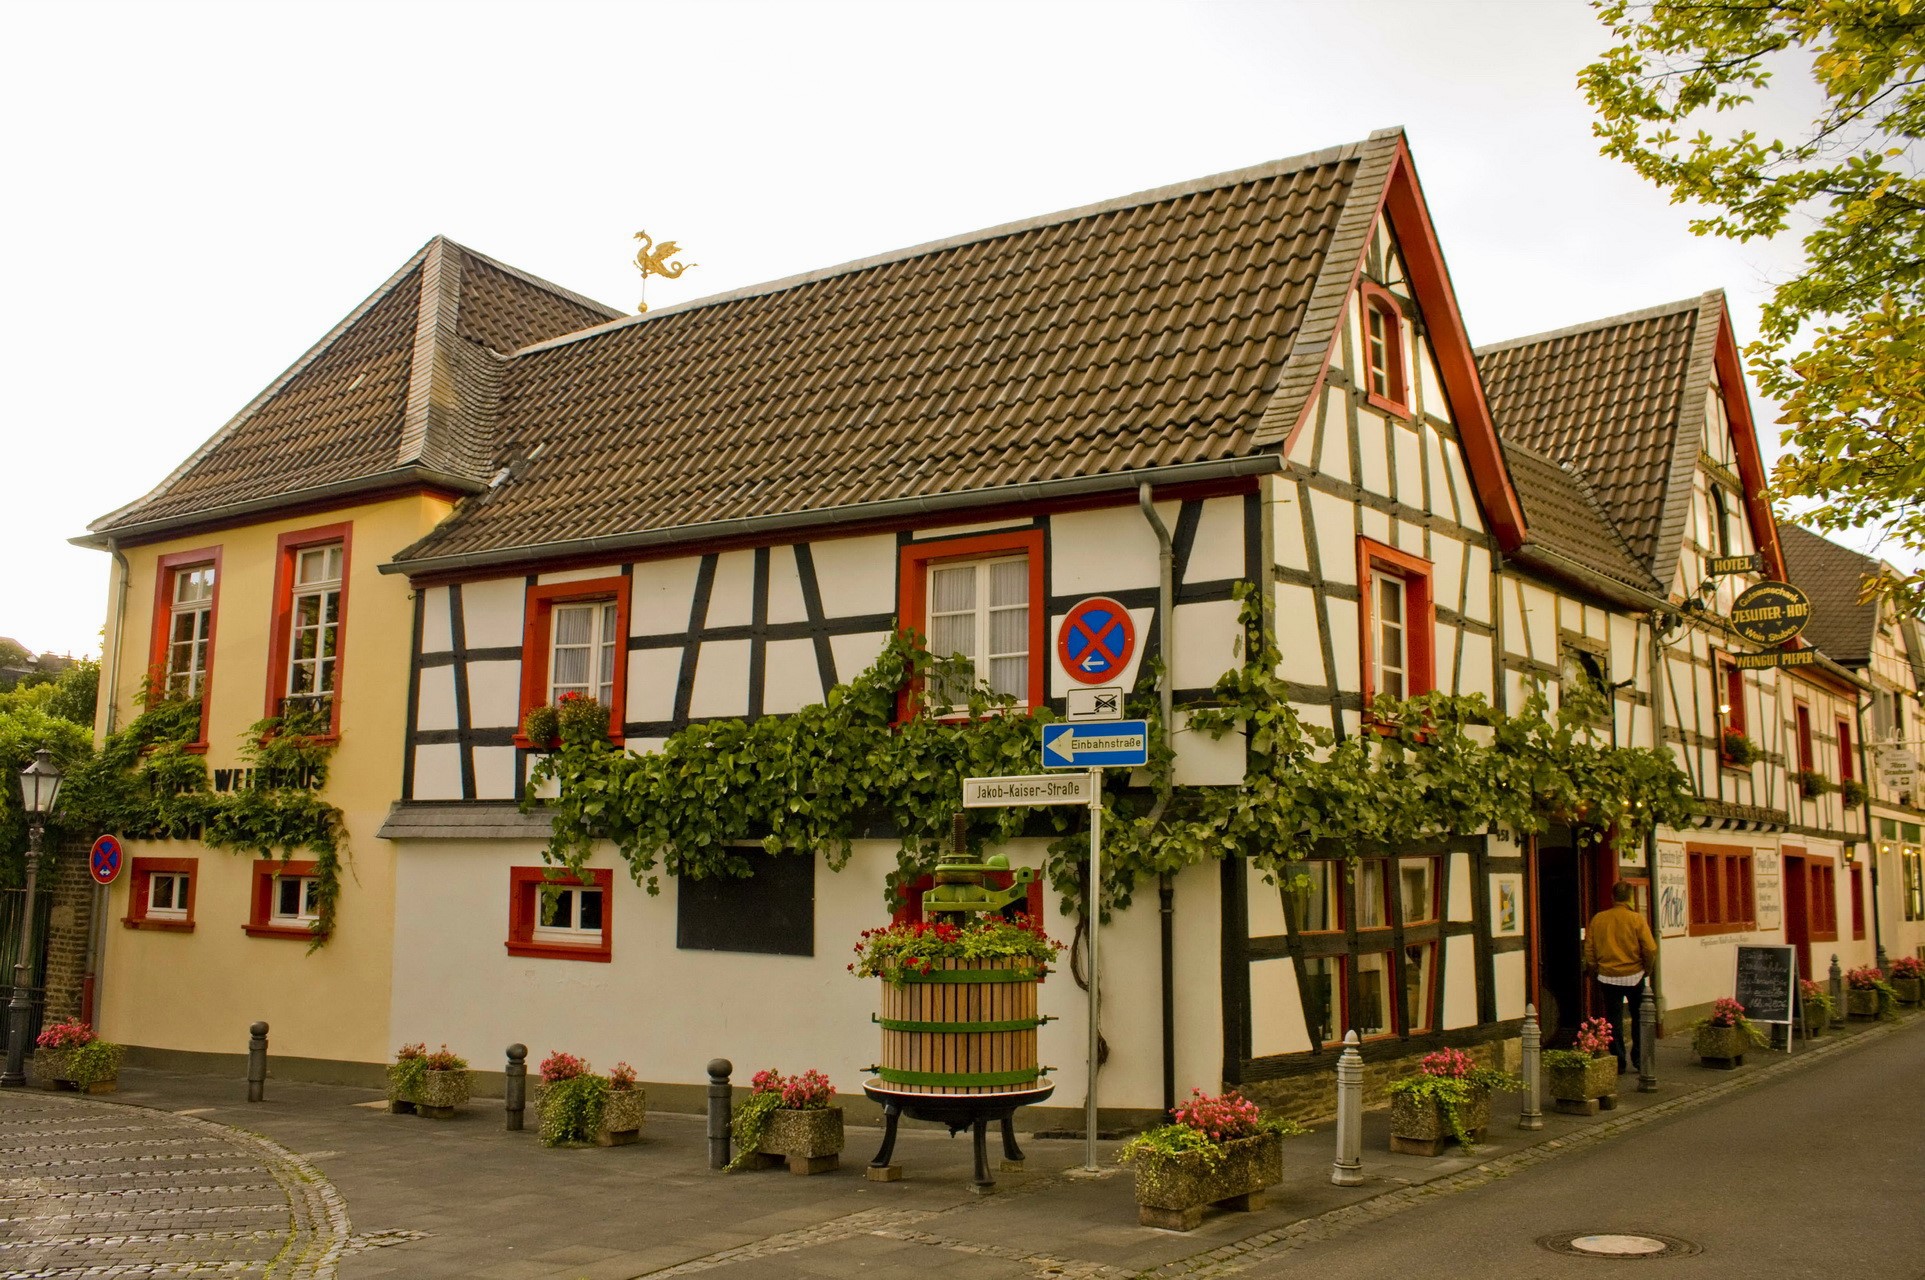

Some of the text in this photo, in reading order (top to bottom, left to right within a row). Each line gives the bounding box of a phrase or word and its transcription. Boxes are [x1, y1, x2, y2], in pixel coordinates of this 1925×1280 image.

[1714, 556, 1752, 572] HOTEL
[1745, 625, 1798, 642] Wein Stuben
[1735, 652, 1813, 669] WEINGUT PIEPER
[1071, 737, 1141, 750] Einbahnstraße
[977, 782, 1080, 799] Jakob-Kaiser-Straße
[1661, 886, 1687, 928] Hotel
